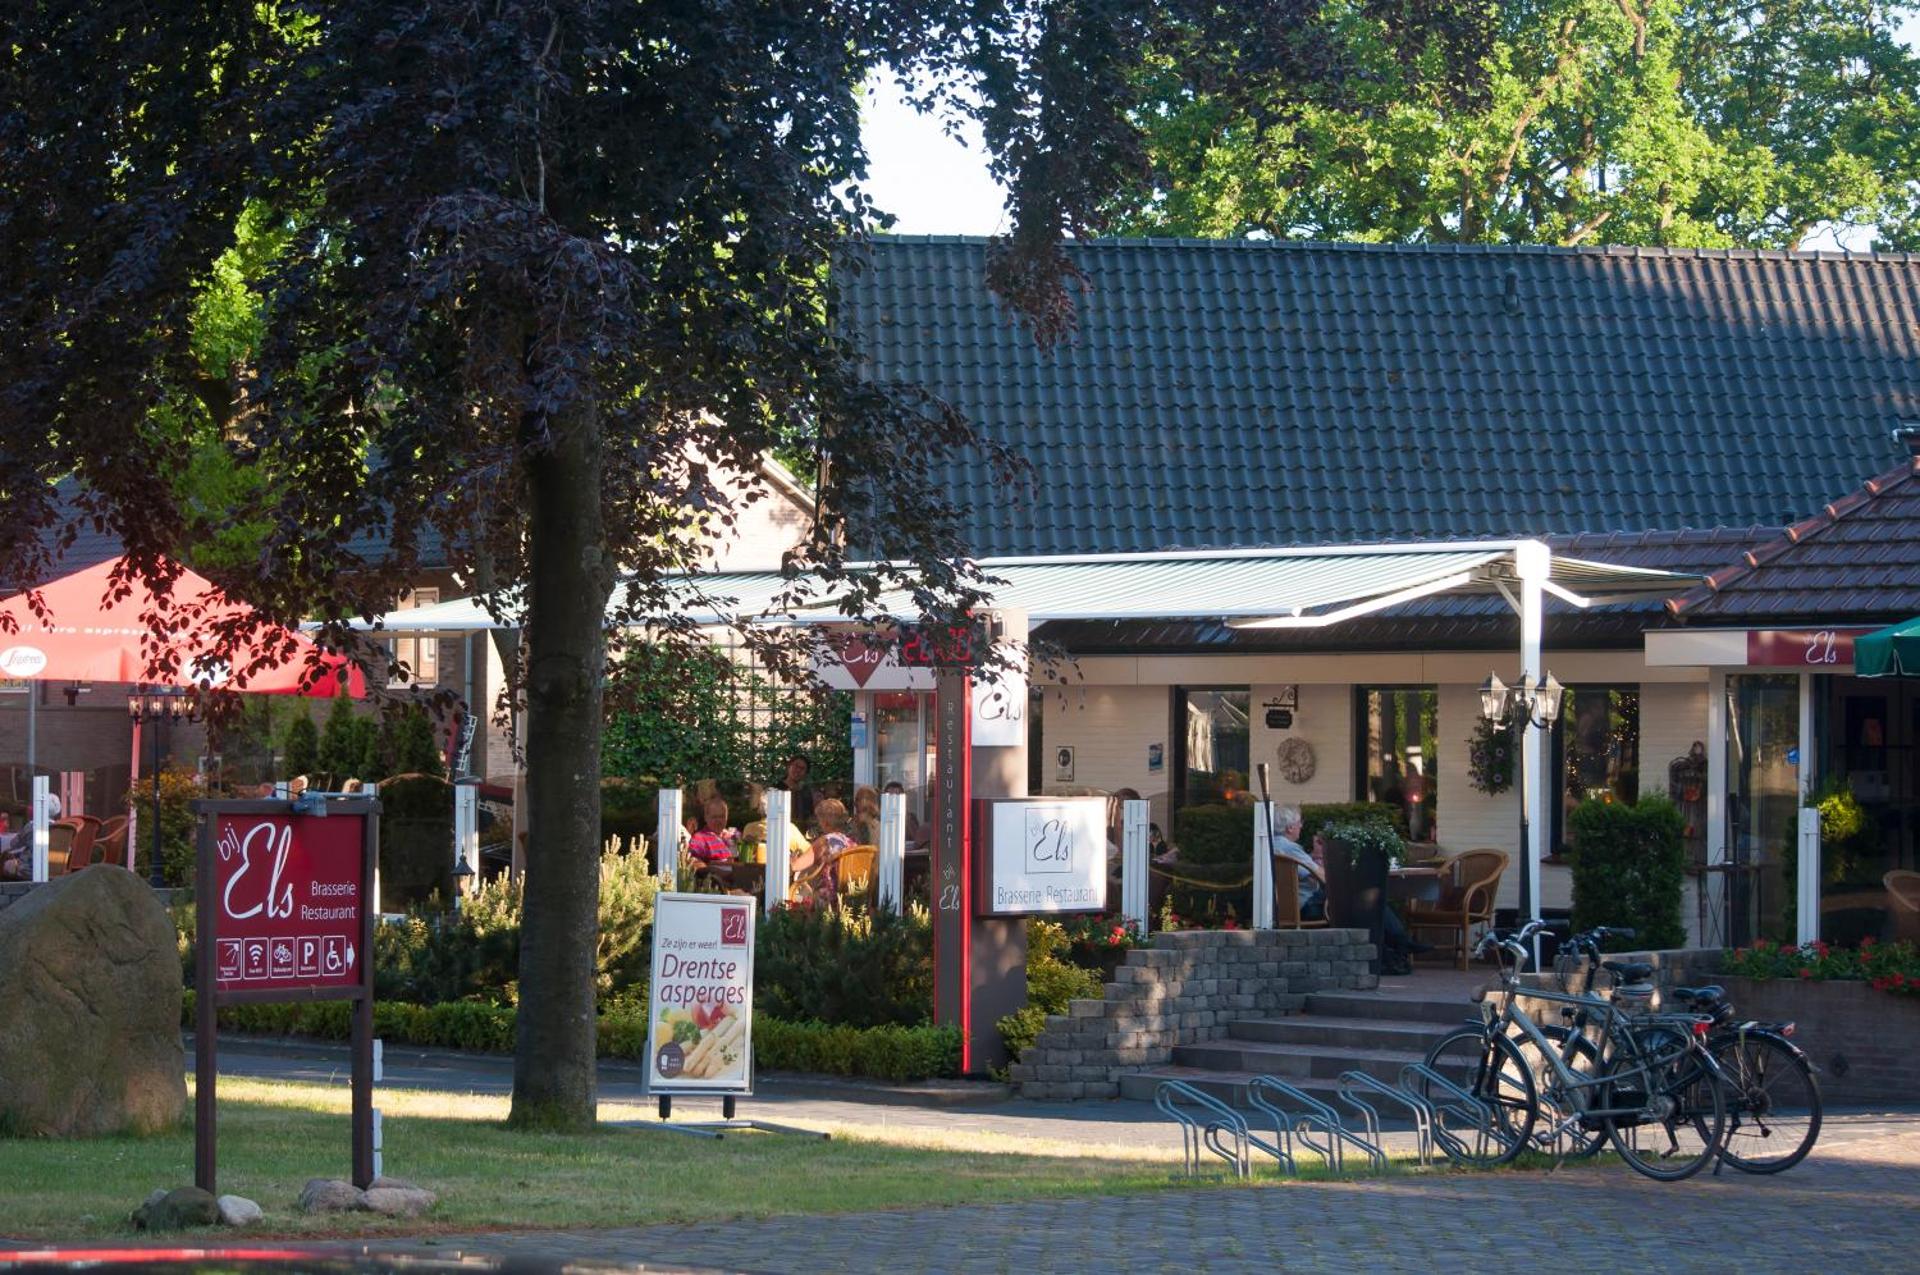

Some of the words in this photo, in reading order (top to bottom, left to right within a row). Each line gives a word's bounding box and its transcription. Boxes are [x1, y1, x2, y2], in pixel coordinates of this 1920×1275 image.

[1806, 630, 1836, 664] Els
[945, 702, 955, 848] Restaurant
[217, 822, 240, 861] bij
[1033, 818, 1069, 861] Els
[224, 822, 294, 919] Els
[311, 881, 356, 896] Brasserie
[939, 885, 960, 910] Els
[997, 886, 1041, 905] Brasserie
[1046, 885, 1098, 904] Restaurant
[301, 904, 356, 920] Restaurant
[661, 938, 673, 948] Ze
[673, 939, 688, 951] zijn
[688, 941, 697, 949] er
[661, 953, 737, 980] Drentse
[660, 984, 745, 1009] asperges
